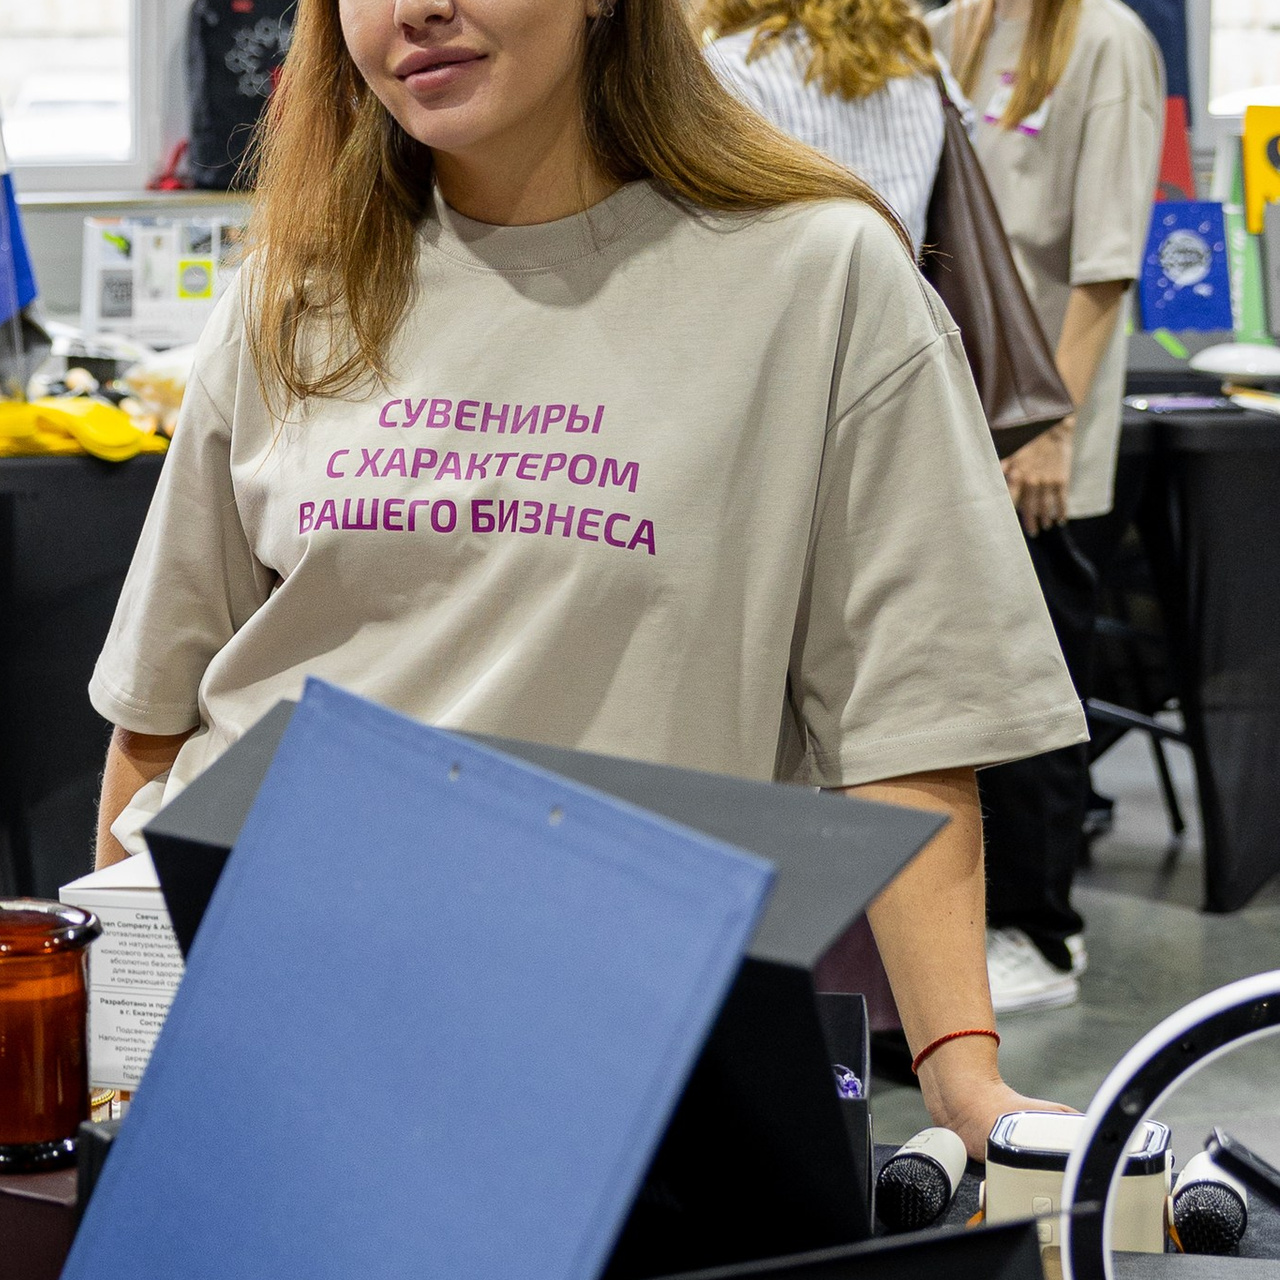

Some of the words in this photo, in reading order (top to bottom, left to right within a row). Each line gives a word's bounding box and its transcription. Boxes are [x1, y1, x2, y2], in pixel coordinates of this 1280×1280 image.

[378, 398, 605, 434] СУВЕНИРЫ
[326, 449, 350, 478] С
[355, 448, 640, 493] ХАРАКТЕРОМ
[298, 498, 458, 535] ВАШЕГО
[471, 499, 657, 555] БИЗНЕСА
[116, 921, 151, 930] Company
